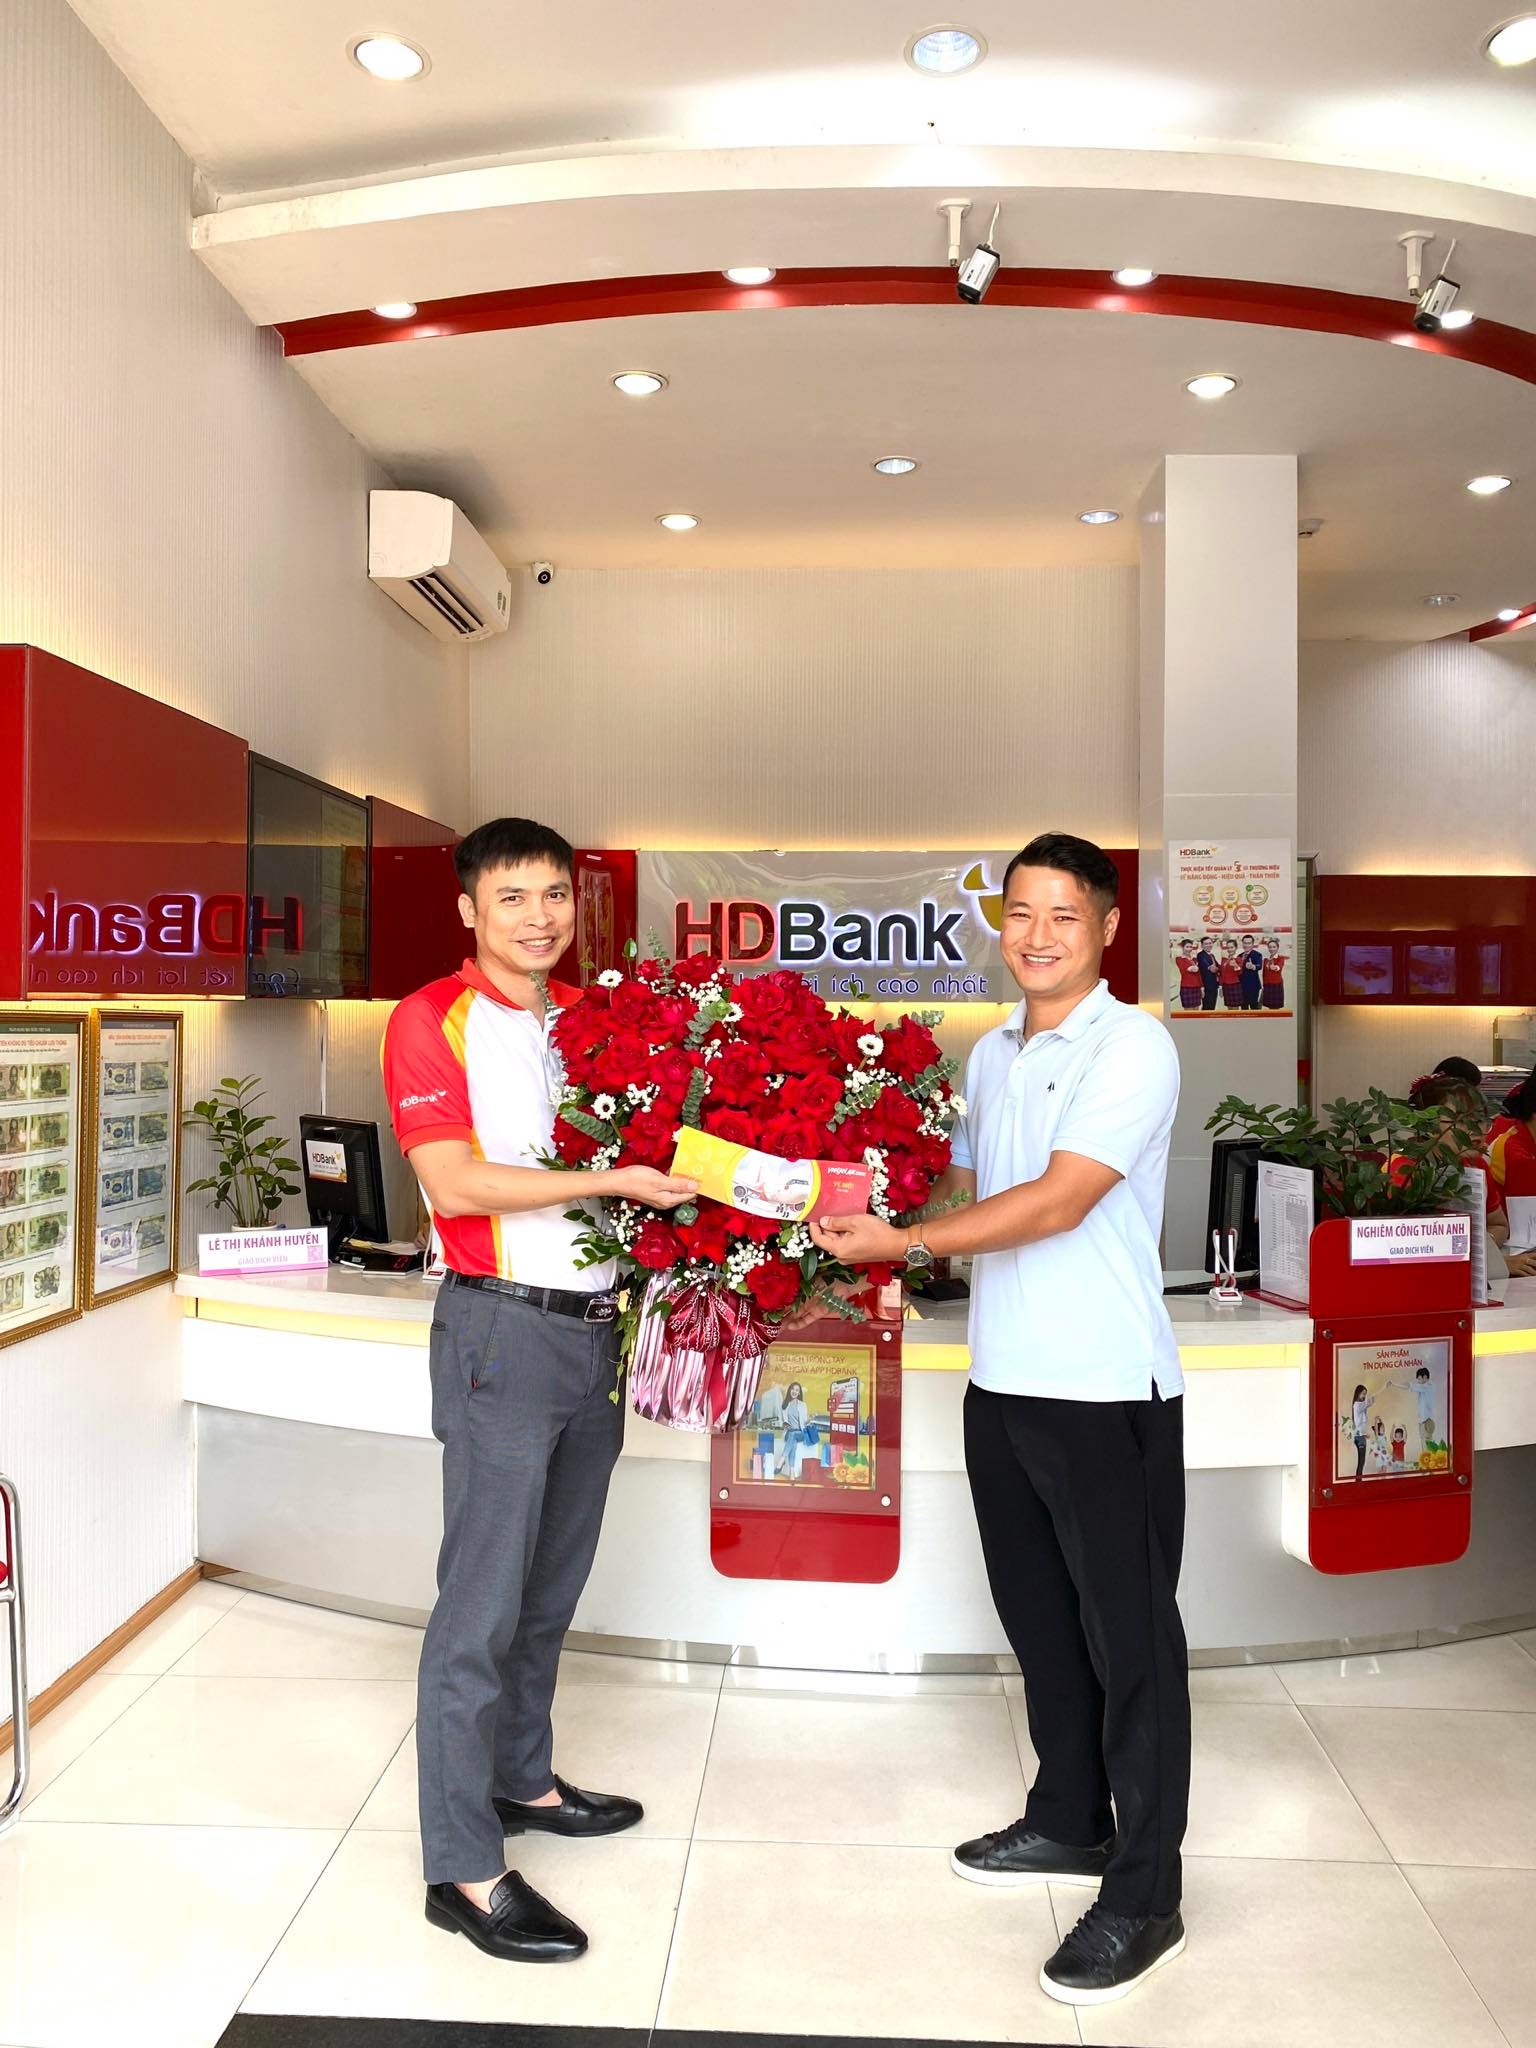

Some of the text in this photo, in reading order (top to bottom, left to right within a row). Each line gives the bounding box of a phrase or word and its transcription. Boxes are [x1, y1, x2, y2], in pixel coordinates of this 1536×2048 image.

[675, 901, 964, 962] HDBank
[832, 973, 863, 993] ích
[877, 977, 919, 993] cao
[933, 973, 988, 993] nhất
[399, 1094, 438, 1109] HDBank
[312, 1152, 336, 1165] HDBank
[1357, 1224, 1393, 1238] NGHIÊM
[1395, 1223, 1419, 1236] CÔNG
[1444, 1223, 1464, 1235] ANH
[209, 1238, 220, 1250] LÊ
[223, 1239, 241, 1252] THỊ
[244, 1235, 281, 1249] KHÁNH
[1390, 1245, 1434, 1256] GIAO DỊCH VIÊN
[1376, 1349, 1389, 1359] SẢN
